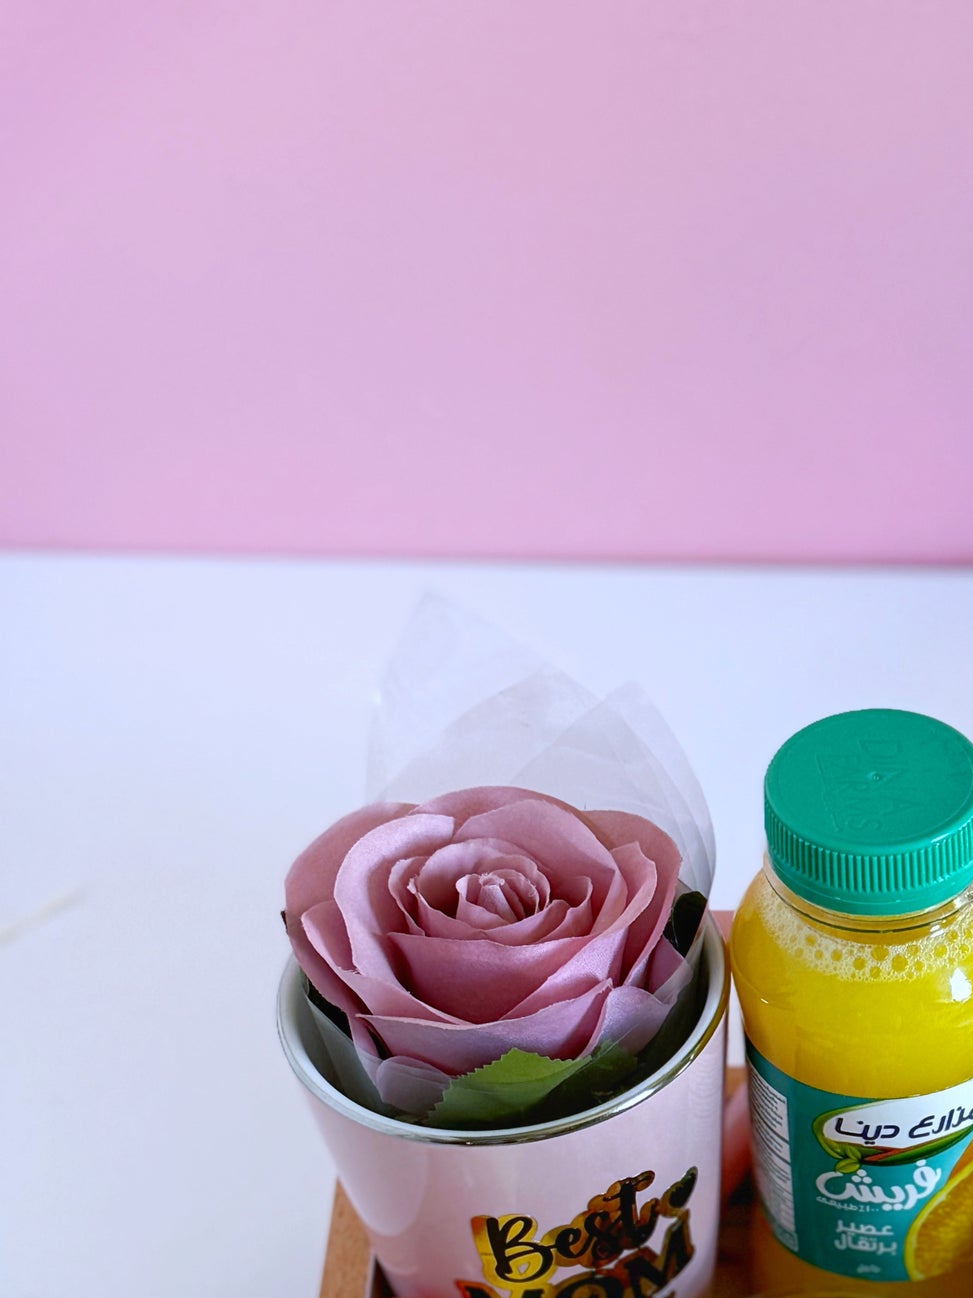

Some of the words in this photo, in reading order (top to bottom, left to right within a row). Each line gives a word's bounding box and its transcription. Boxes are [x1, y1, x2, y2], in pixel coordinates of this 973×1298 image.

[834, 1116, 900, 1146] دينا
[815, 1159, 943, 1212] فريش
[480, 1169, 661, 1284] Best
[835, 1219, 894, 1236] عصير
[833, 1232, 898, 1256] برتقال
